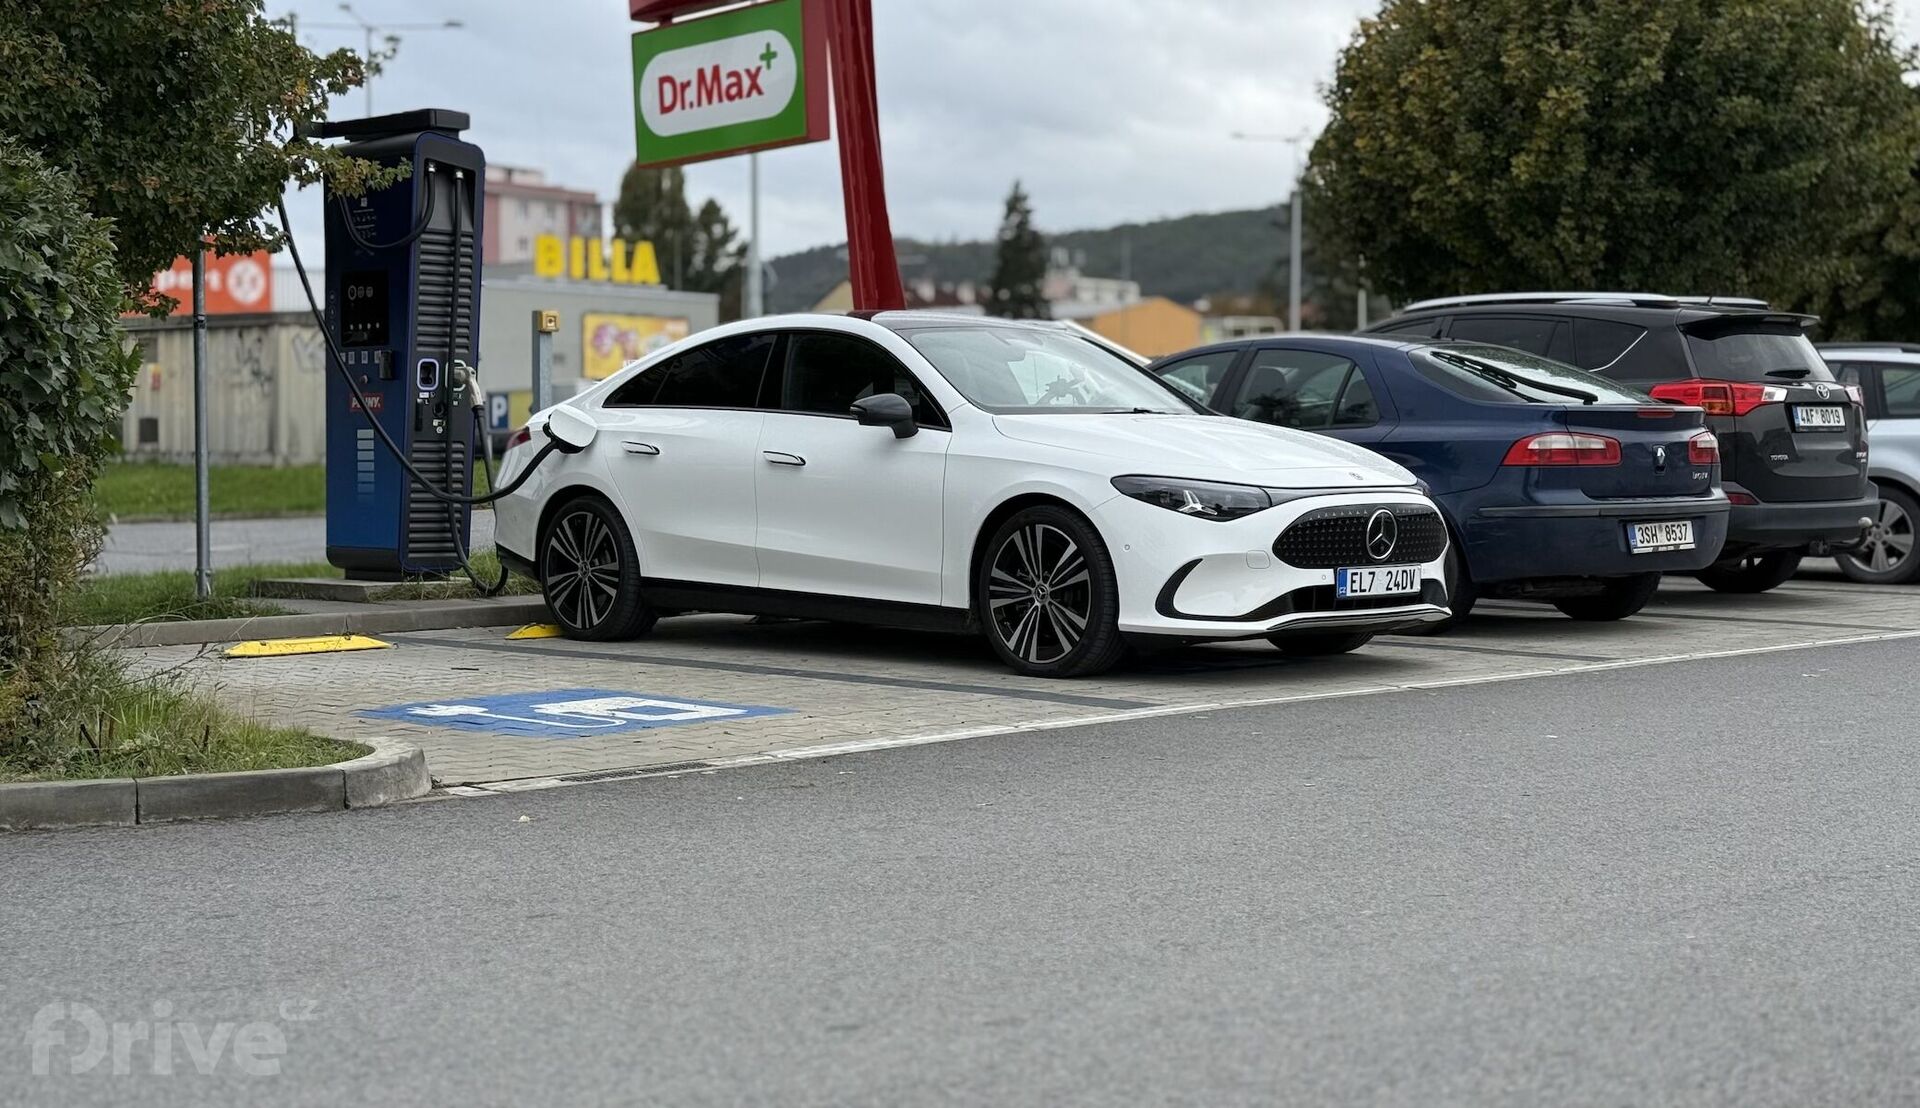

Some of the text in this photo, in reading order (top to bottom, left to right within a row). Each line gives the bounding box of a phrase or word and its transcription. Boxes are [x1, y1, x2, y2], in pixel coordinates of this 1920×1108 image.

[535, 234, 661, 284] BILLA
[492, 396, 507, 427] P
[1801, 408, 1841, 424] 4AF 8019
[1638, 523, 1688, 544] 3SH 8537
[1350, 571, 1376, 593] EL7
[1386, 569, 1416, 592] 24DV
